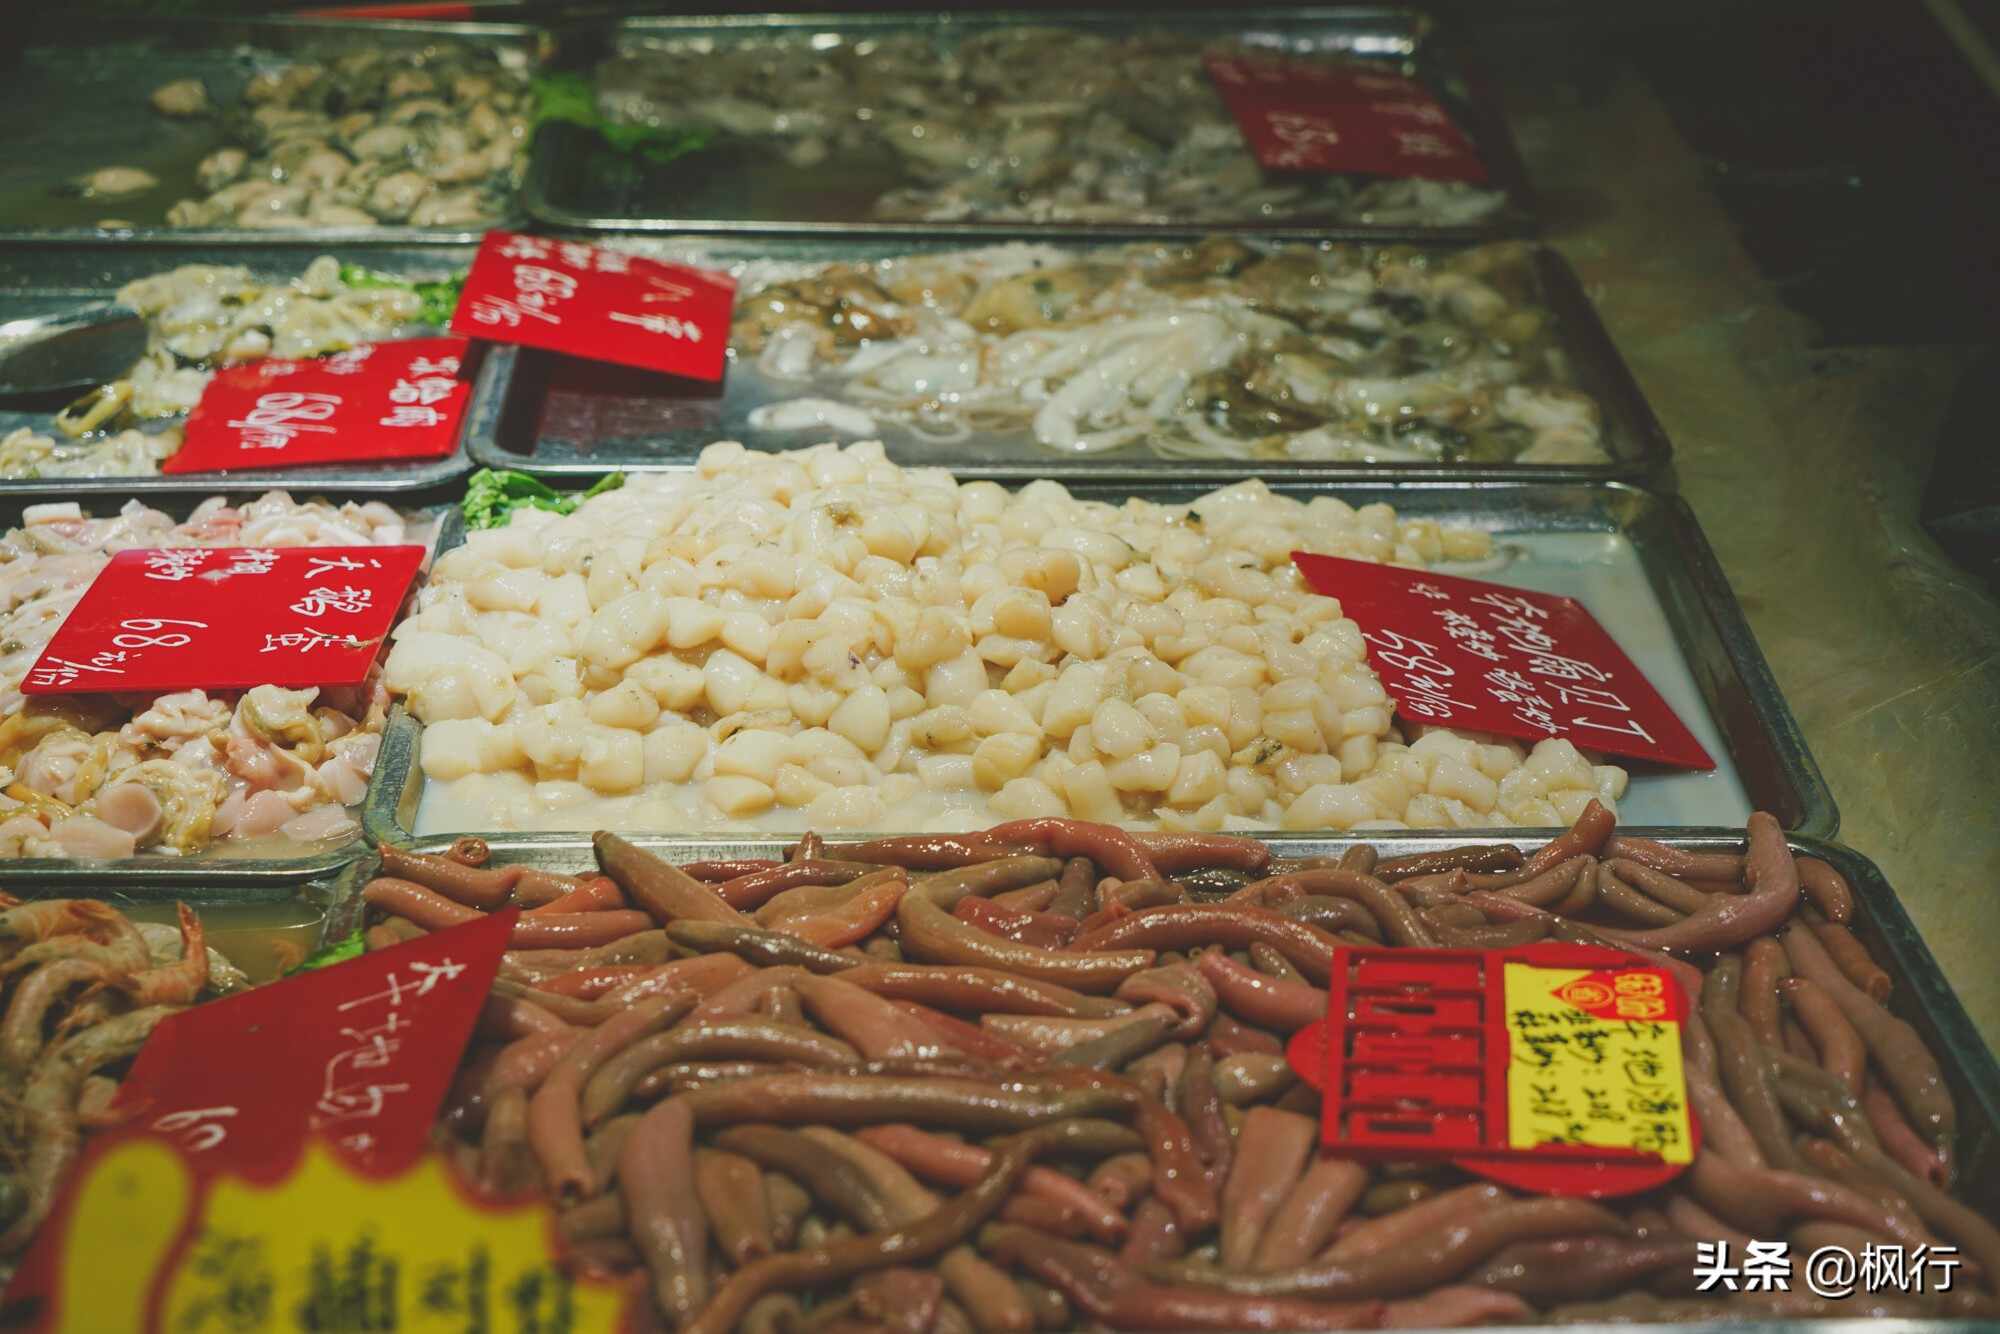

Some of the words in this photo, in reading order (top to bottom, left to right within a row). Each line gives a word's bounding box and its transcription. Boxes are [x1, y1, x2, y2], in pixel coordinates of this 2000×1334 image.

[260, 557, 381, 653] 天鹅蛋
[31, 618, 208, 685] 68元/份
[1362, 629, 1477, 718] 58元/份
[1469, 593, 1656, 744] 本地扇贝丁
